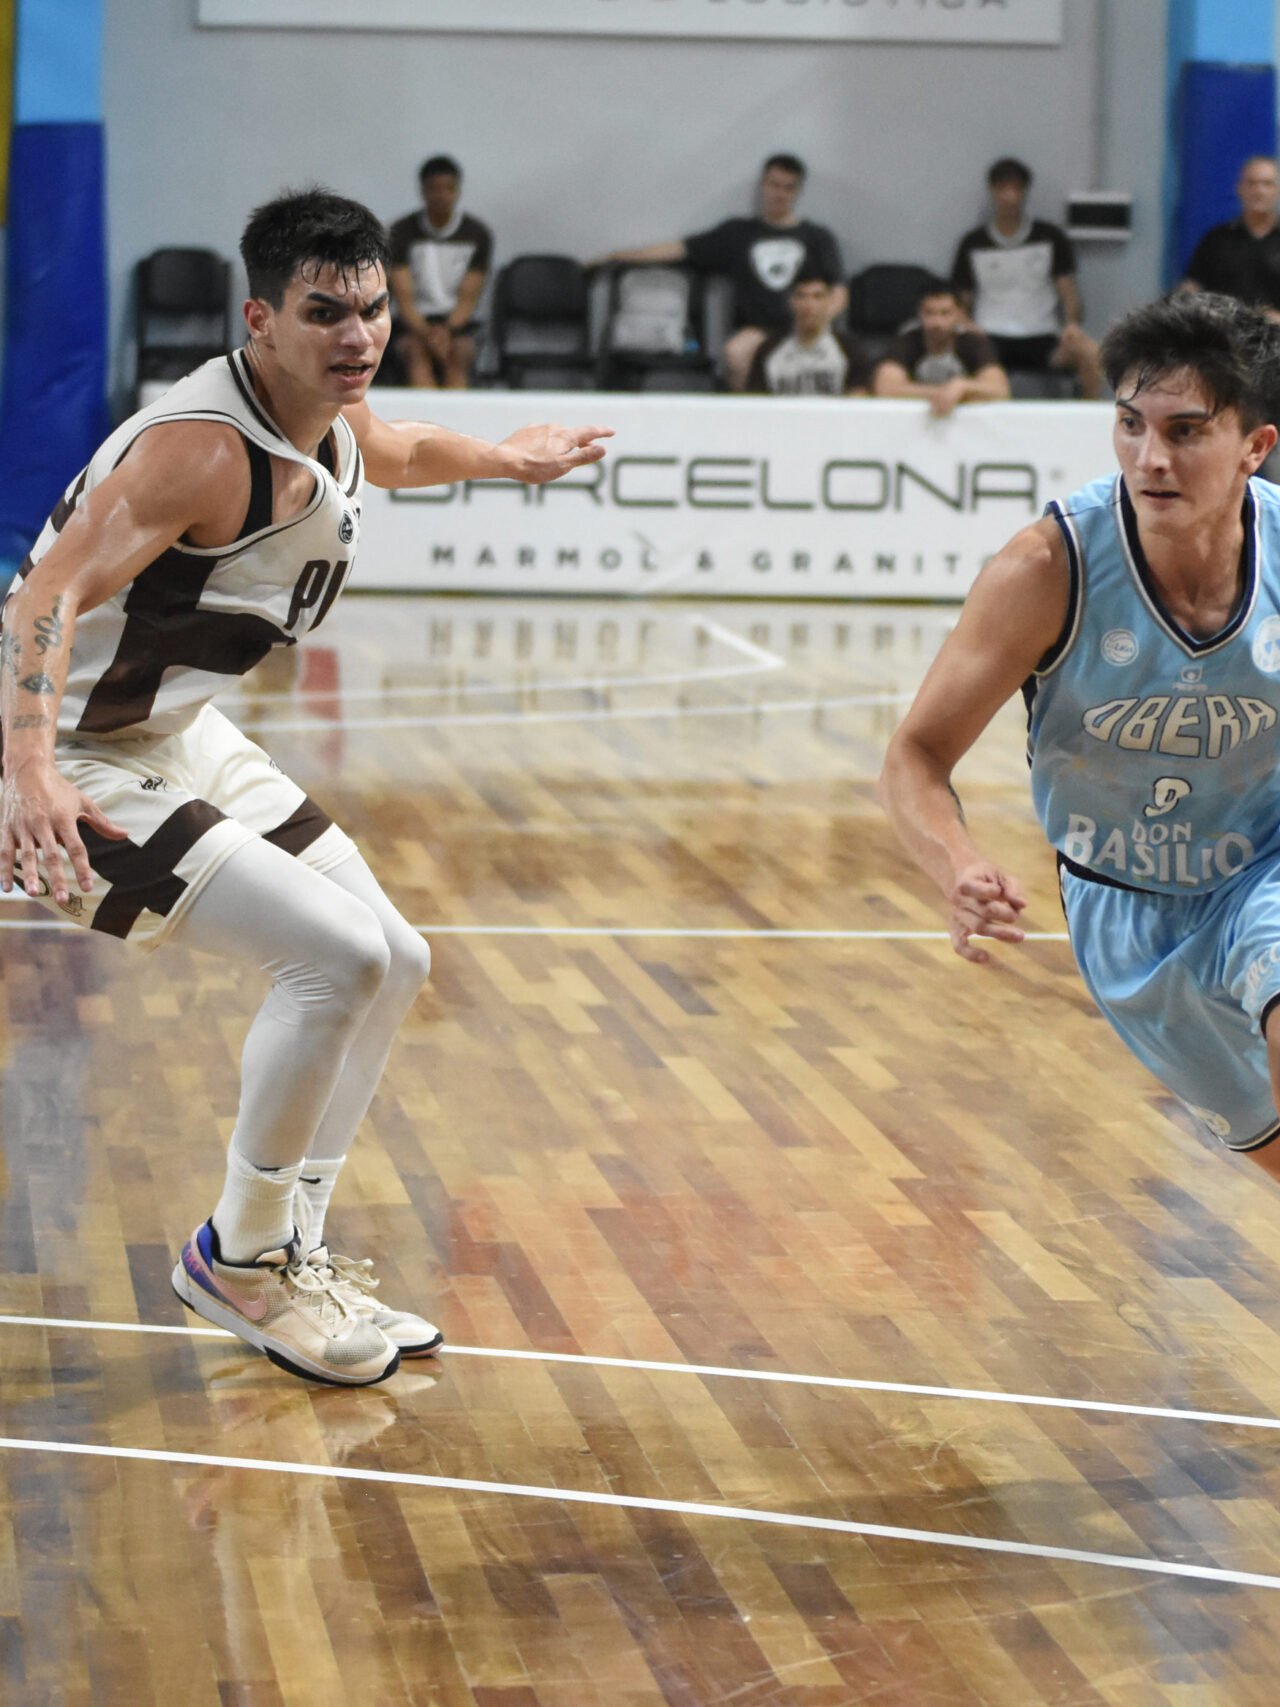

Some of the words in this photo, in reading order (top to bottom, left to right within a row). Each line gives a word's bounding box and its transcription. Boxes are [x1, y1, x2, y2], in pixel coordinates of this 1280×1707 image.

[388, 457, 1037, 513] RCELONA
[431, 546, 660, 571] MARMOL
[752, 552, 993, 575] GRANIT
[1081, 695, 1278, 759] OBERA
[1142, 776, 1192, 817] 9
[1064, 813, 1255, 885] BASILIO
[1131, 819, 1192, 845] DON
